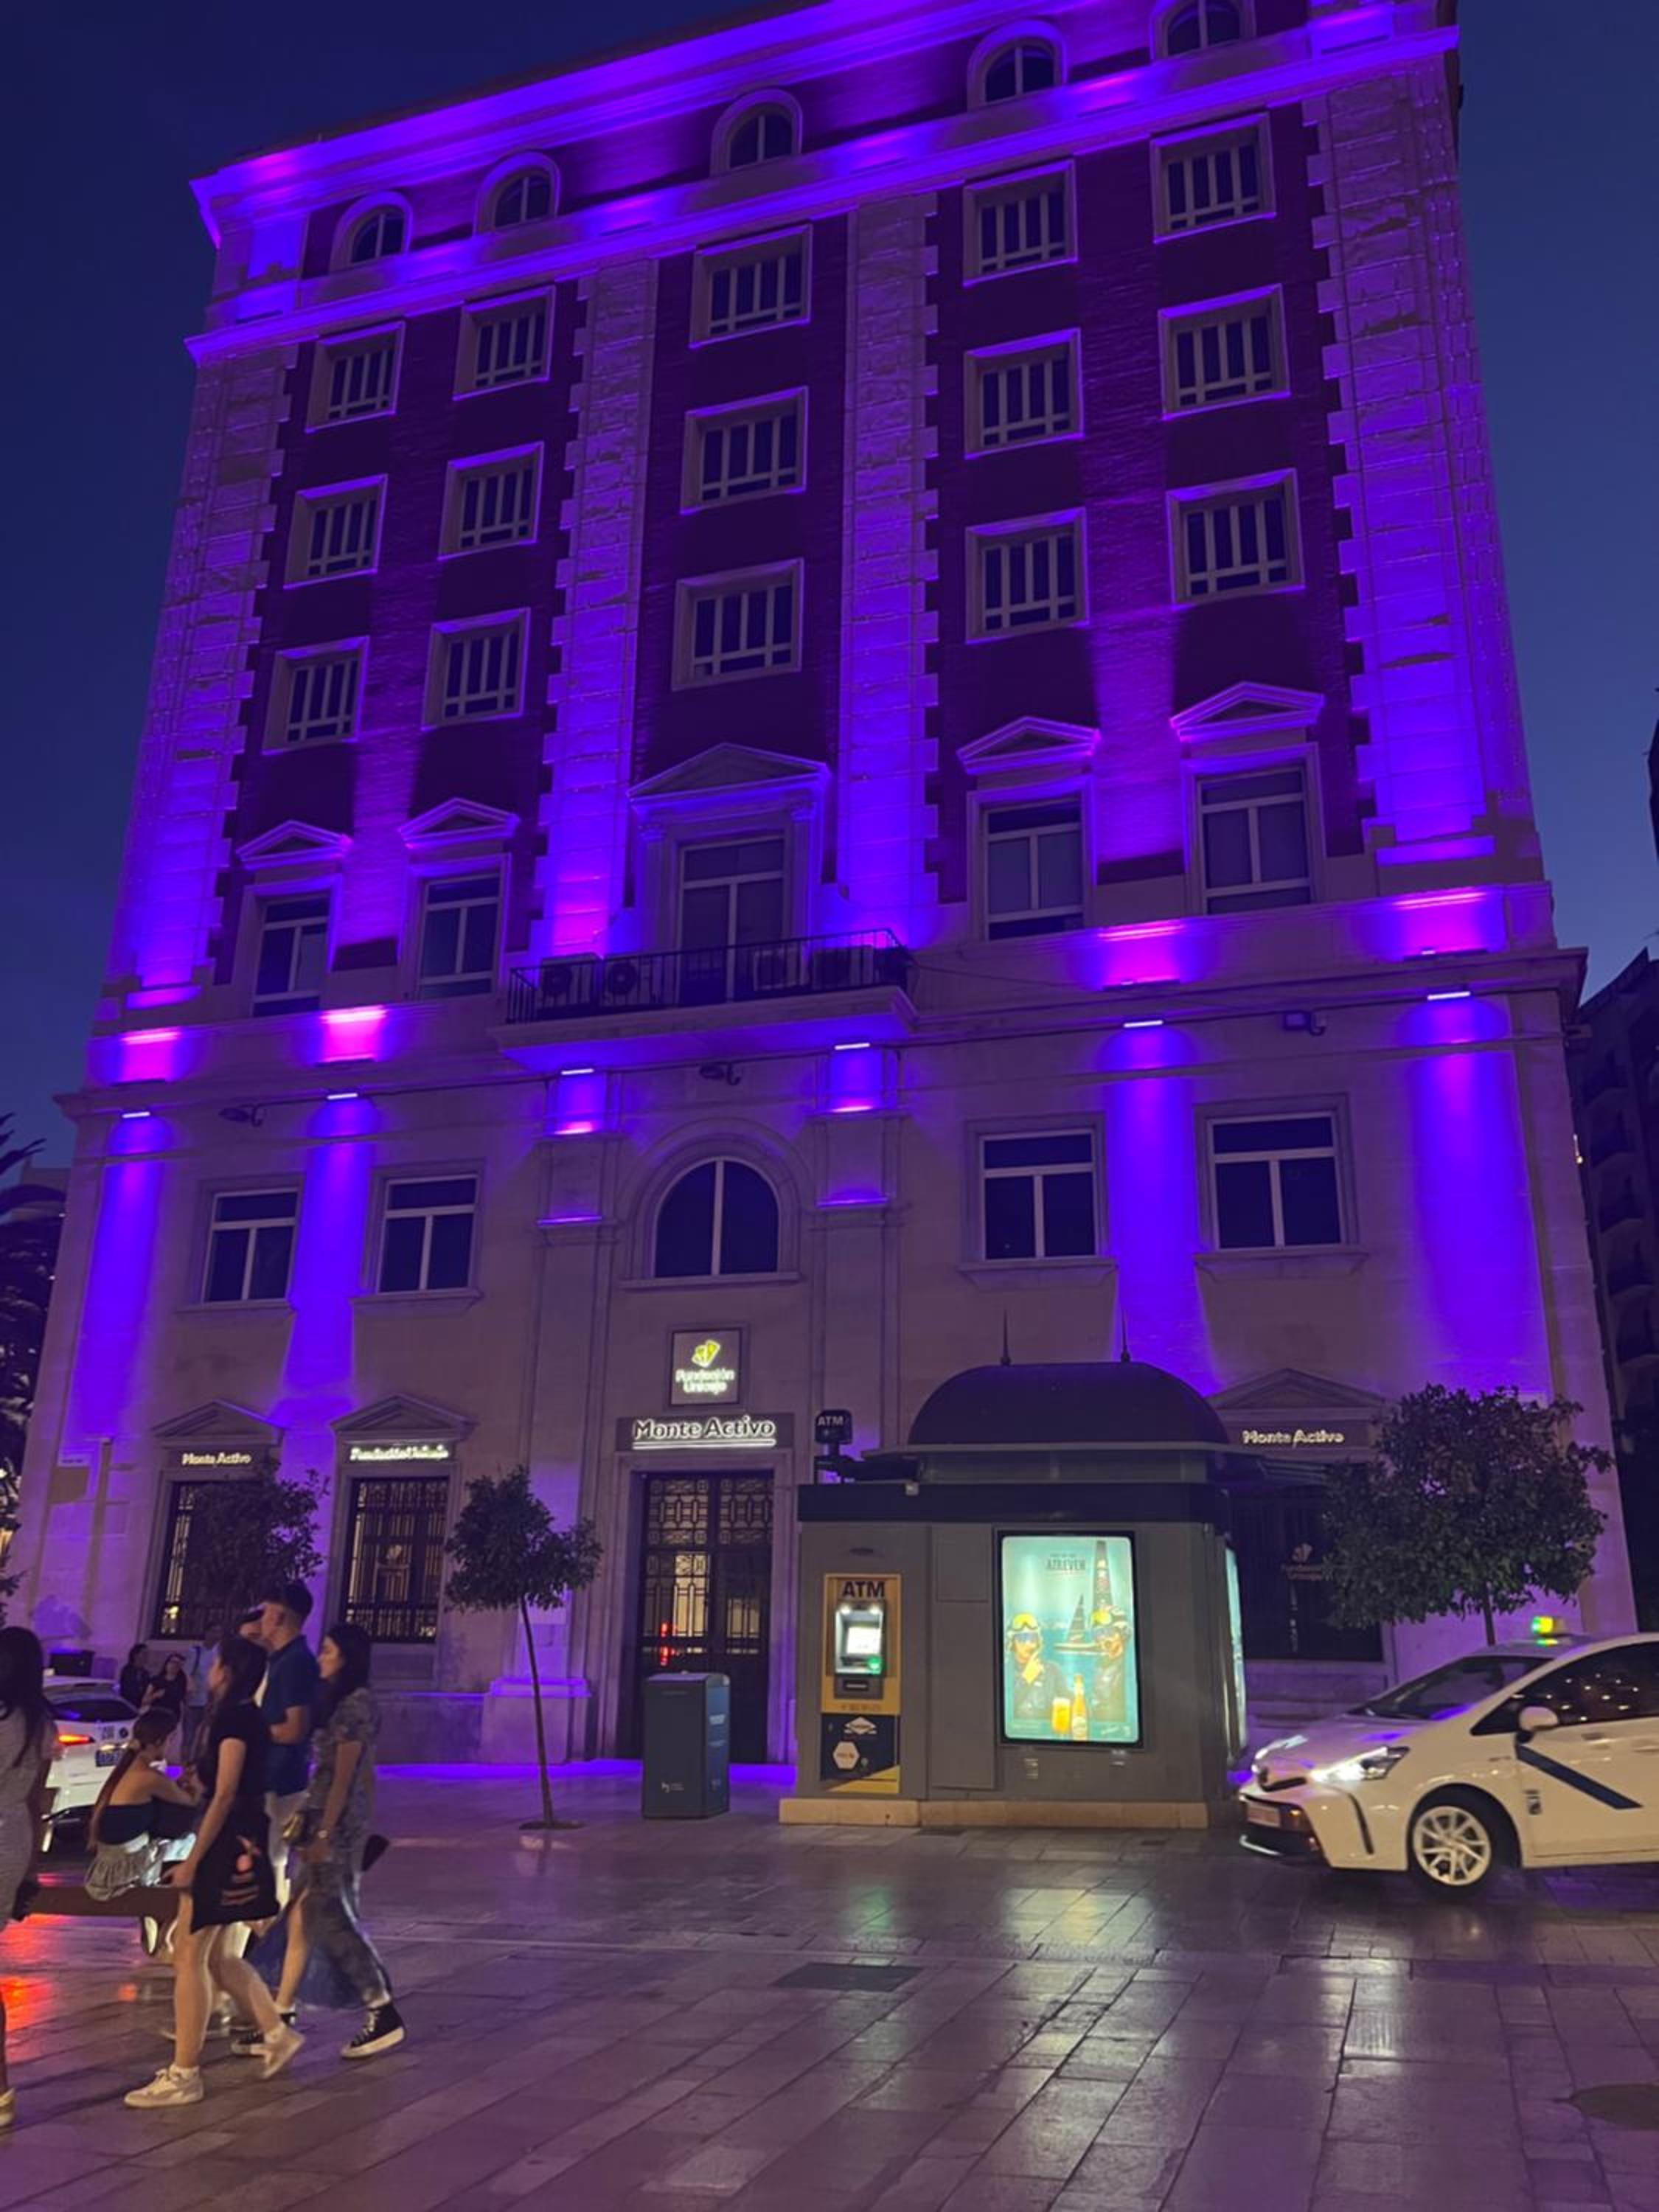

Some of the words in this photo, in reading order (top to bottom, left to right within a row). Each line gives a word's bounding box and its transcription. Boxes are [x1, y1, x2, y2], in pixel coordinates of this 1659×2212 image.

[633, 1419, 701, 1439] Monte
[704, 1414, 776, 1438] Activo
[818, 1416, 844, 1427] ATM
[1242, 1430, 1291, 1444] Monte
[1293, 1429, 1345, 1443] Activo
[842, 1580, 885, 1598] ATM
